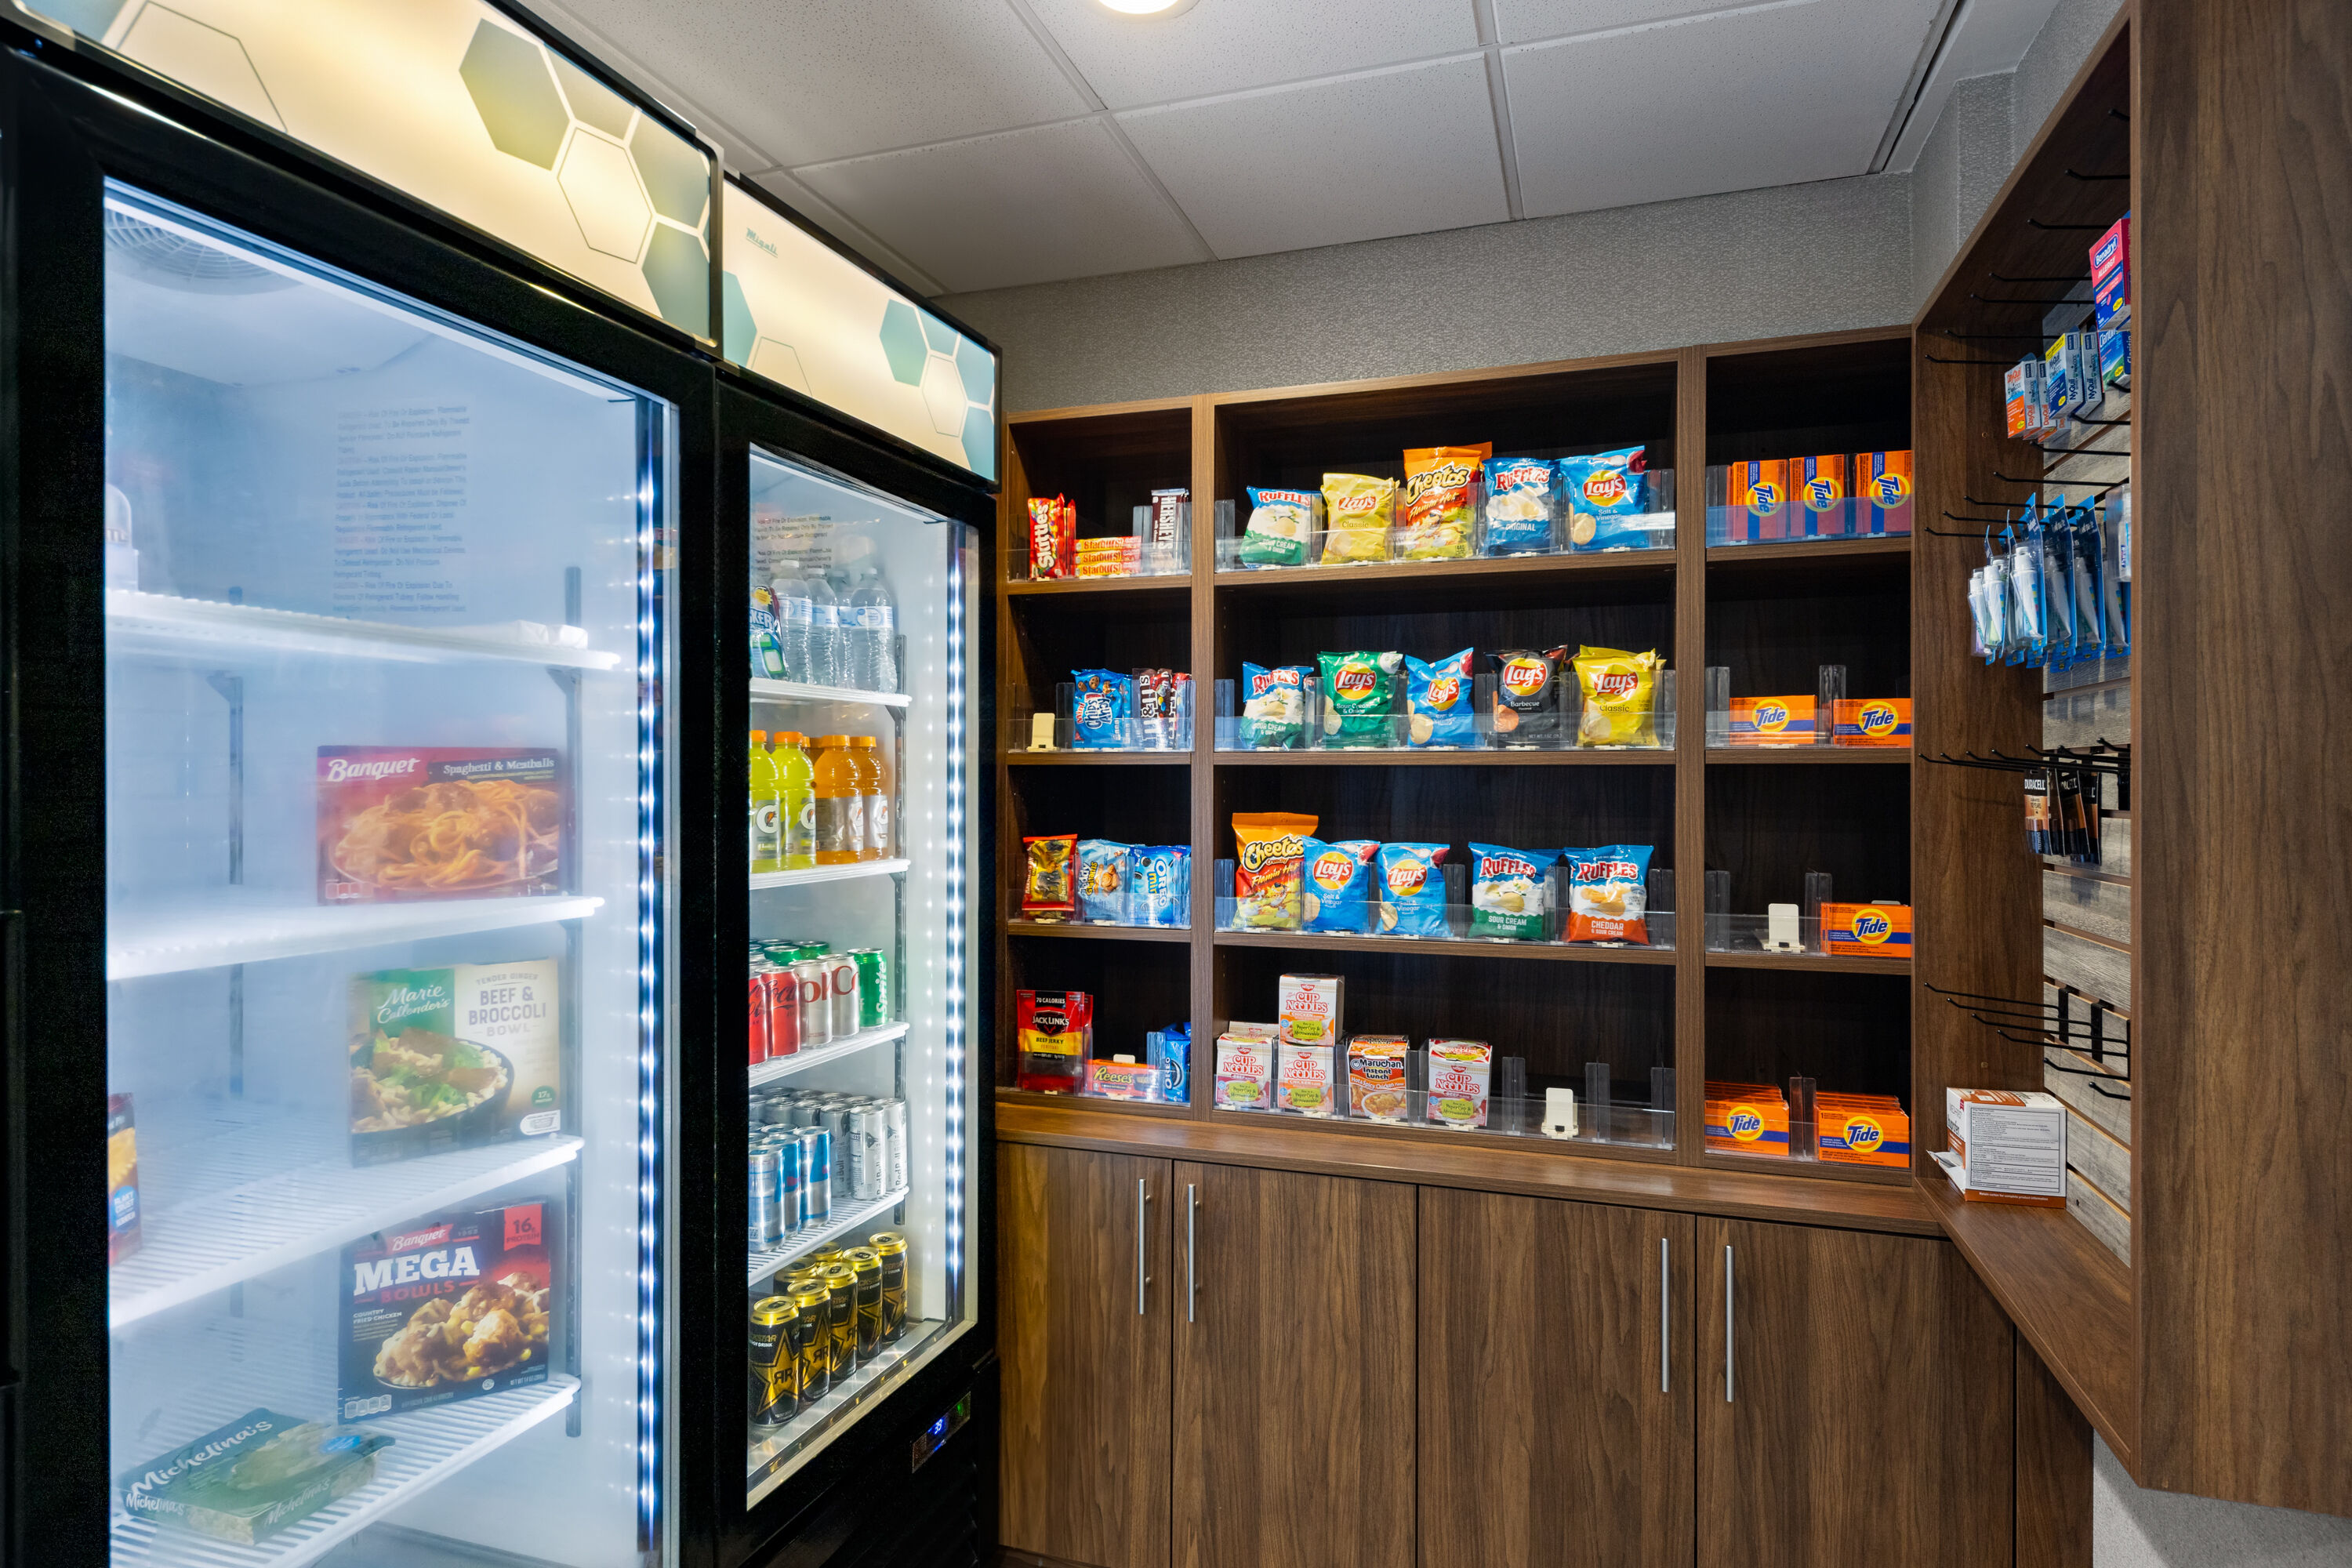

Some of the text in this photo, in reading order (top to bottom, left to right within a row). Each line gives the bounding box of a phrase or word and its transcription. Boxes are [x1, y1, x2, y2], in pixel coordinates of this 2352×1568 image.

[2096, 238, 2117, 266] Benadryl
[2097, 256, 2116, 278] ALLERGY
[2069, 379, 2078, 401] NyQuil
[2087, 379, 2096, 400] NyQuil
[1406, 464, 1470, 506] Cheetos
[1494, 466, 1551, 492] RUFFLES
[1586, 476, 1625, 499] Lay's
[1258, 491, 1311, 507] RUFFLES
[1439, 492, 1460, 505] Hot
[1753, 484, 1777, 514] Tide
[1809, 480, 1833, 509] Tide
[1877, 476, 1902, 506] Tide
[1339, 495, 1377, 510] Lay's
[1341, 520, 1370, 529] Classic
[1504, 522, 1537, 532] ORIGINAL
[1034, 503, 1055, 570] Skittles
[1083, 539, 1124, 550] Starburst
[1262, 539, 1296, 550] SOUR CREAM
[1082, 551, 1123, 563] Starburst
[1081, 564, 1122, 575] Starburst
[1251, 670, 1300, 696] RUFFLES
[1337, 670, 1377, 691] Lay's
[1505, 665, 1544, 688] Lay's
[1596, 673, 1638, 695] Lay's
[1428, 681, 1458, 703] Lay's
[1076, 702, 1086, 724] Mini
[1085, 699, 1102, 729] Chips
[1599, 703, 1630, 713] Classic
[1755, 706, 1788, 728] Tide
[1268, 724, 1287, 732] CREAM
[1861, 708, 1896, 731] Tide
[326, 757, 421, 782] Banquet
[443, 762, 492, 776] Spaghetti
[494, 761, 503, 771] &
[506, 757, 554, 771] Meatballs
[2024, 779, 2046, 790] DURACELL
[1243, 835, 1305, 873] Cheetos
[1251, 867, 1282, 887] Flamin'
[1314, 859, 1352, 882] Lay's
[1388, 867, 1427, 888] Lay's
[1479, 856, 1537, 879] RUFFLES
[1576, 861, 1639, 883] RUFFLES
[1155, 858, 1168, 907] OREO
[1319, 898, 1343, 907] Vinegar
[1488, 915, 1527, 926] SOUR CREAM
[1591, 920, 1624, 931] CHEDDAR
[1855, 916, 1889, 938] Tide
[480, 985, 534, 1006] BEEF &
[875, 956, 888, 1014] Sprite
[377, 984, 446, 1010] Marie
[1286, 1000, 1328, 1013] NOODLES
[1295, 991, 1320, 1002] CUP
[376, 997, 452, 1024] Callender's
[468, 1002, 546, 1025] BROCCOLI
[1032, 1015, 1048, 1025] JACK
[486, 1023, 531, 1037] BOWL
[1223, 1062, 1264, 1076] NOODLES
[1232, 1054, 1256, 1065] CUP
[1293, 1059, 1317, 1069] CUP
[1359, 1058, 1402, 1069] Maruchan
[1093, 1065, 1134, 1084] Reese's
[1283, 1067, 1326, 1080] NOODLES
[1445, 1073, 1472, 1083] CUP
[1363, 1080, 1375, 1090] Spicy
[1436, 1078, 1480, 1094] NOODLES
[1729, 1114, 1762, 1135] Tide
[1846, 1124, 1880, 1145] Tide
[392, 1229, 447, 1251] Banquet
[506, 1232, 540, 1244] PROTEIN
[354, 1246, 481, 1297] MEGA
[381, 1280, 456, 1304] BOWLS
[353, 1308, 385, 1319] COUNTRY
[373, 1311, 402, 1322] CHICKEN
[130, 1419, 274, 1494] Michelina's
[125, 1491, 185, 1516] Michelina's
[263, 1477, 332, 1527] Michelina's
